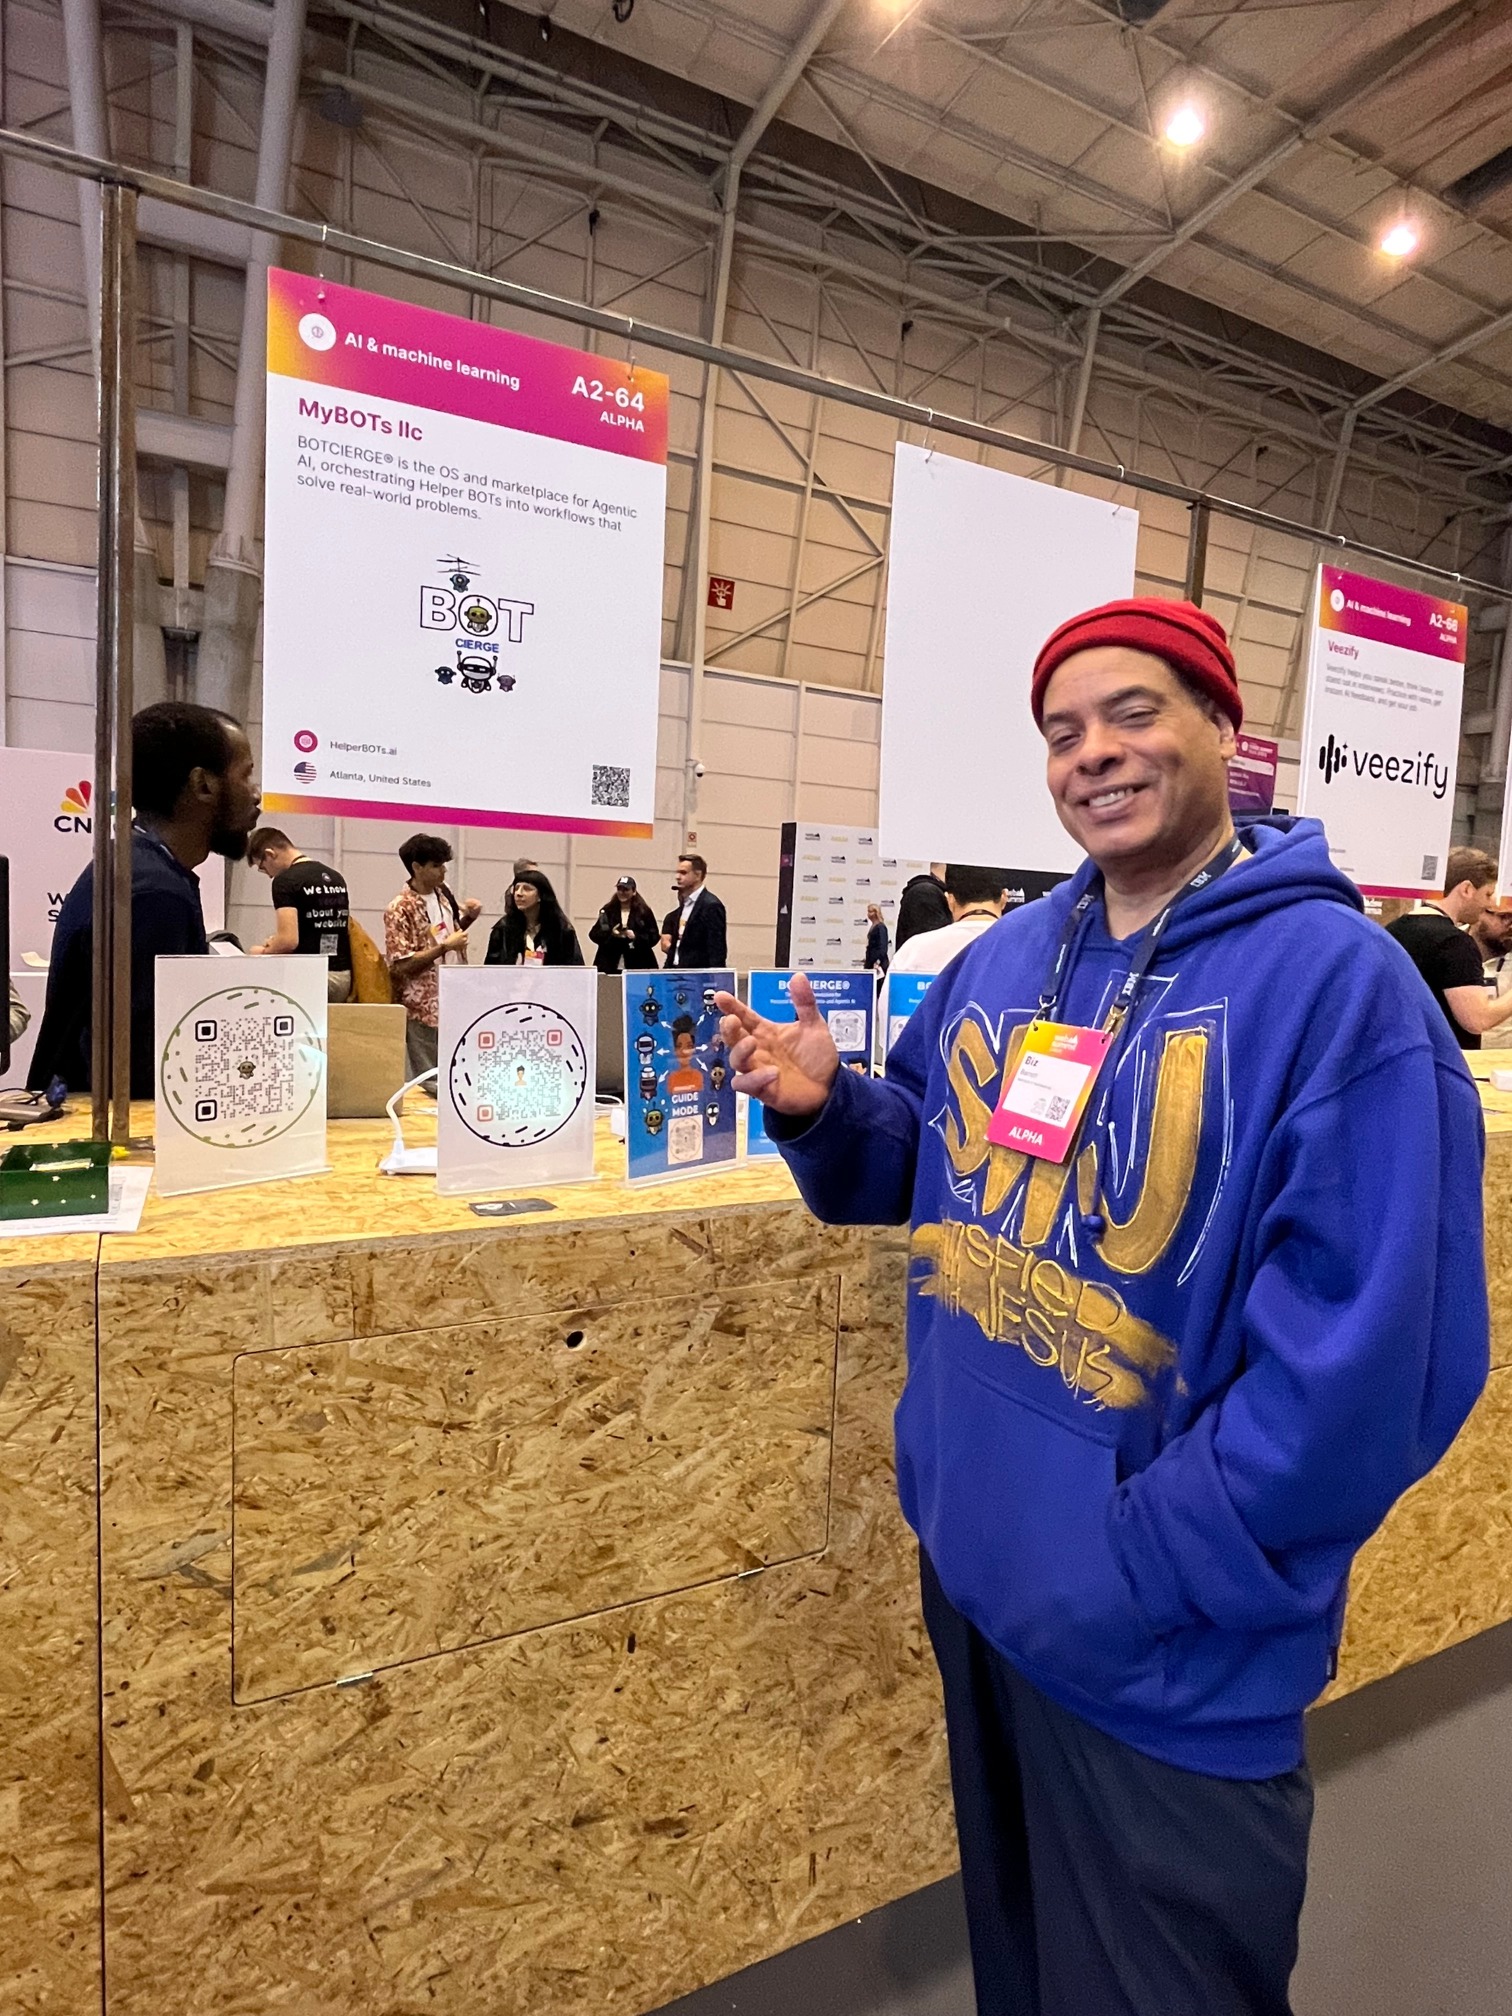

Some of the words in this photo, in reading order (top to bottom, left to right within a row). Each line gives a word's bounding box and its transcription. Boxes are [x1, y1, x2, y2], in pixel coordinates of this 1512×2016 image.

[344, 332, 364, 348] AI
[366, 336, 378, 352] &
[381, 343, 453, 371] machine
[456, 359, 521, 391] learning
[571, 375, 645, 413] A2-64
[298, 397, 393, 435] MyBOTs
[398, 420, 423, 442] llc
[599, 410, 645, 433] ALPHA
[297, 454, 316, 473] AI,
[320, 458, 416, 492] orchestrating
[419, 479, 464, 503] Helper
[468, 489, 502, 508] BOTs
[505, 494, 530, 513] into
[533, 502, 595, 528] workflows
[598, 515, 622, 533] that
[297, 472, 336, 494] solve
[339, 480, 412, 507] real-world
[415, 494, 482, 521] problems.
[397, 455, 409, 470] is
[413, 458, 436, 476] the
[439, 464, 460, 481] OS
[463, 470, 488, 488] and
[491, 476, 570, 508] marketplace
[572, 492, 589, 509] for
[592, 498, 638, 520] Agentic
[420, 585, 535, 643] BOT
[455, 637, 500, 653] CIERGE
[1328, 640, 1360, 660] Veezify
[329, 741, 398, 757] HelperBOTs.ai
[329, 770, 366, 783] Atlanta,
[368, 772, 400, 785] United
[402, 775, 432, 789] States
[1353, 749, 1449, 800] veezify
[54, 815, 92, 834] CN
[1189, 870, 1212, 888] IBM
[303, 885, 322, 896] We
[322, 884, 347, 895] know
[306, 908, 334, 919] about
[778, 979, 851, 991] BIERGE®
[1121, 971, 1140, 996] IBM
[1024, 1055, 1039, 1067] Biz
[671, 1091, 699, 1105] GUIDE
[671, 1104, 699, 1118] MODE
[1008, 1126, 1043, 1147] ALPHA
